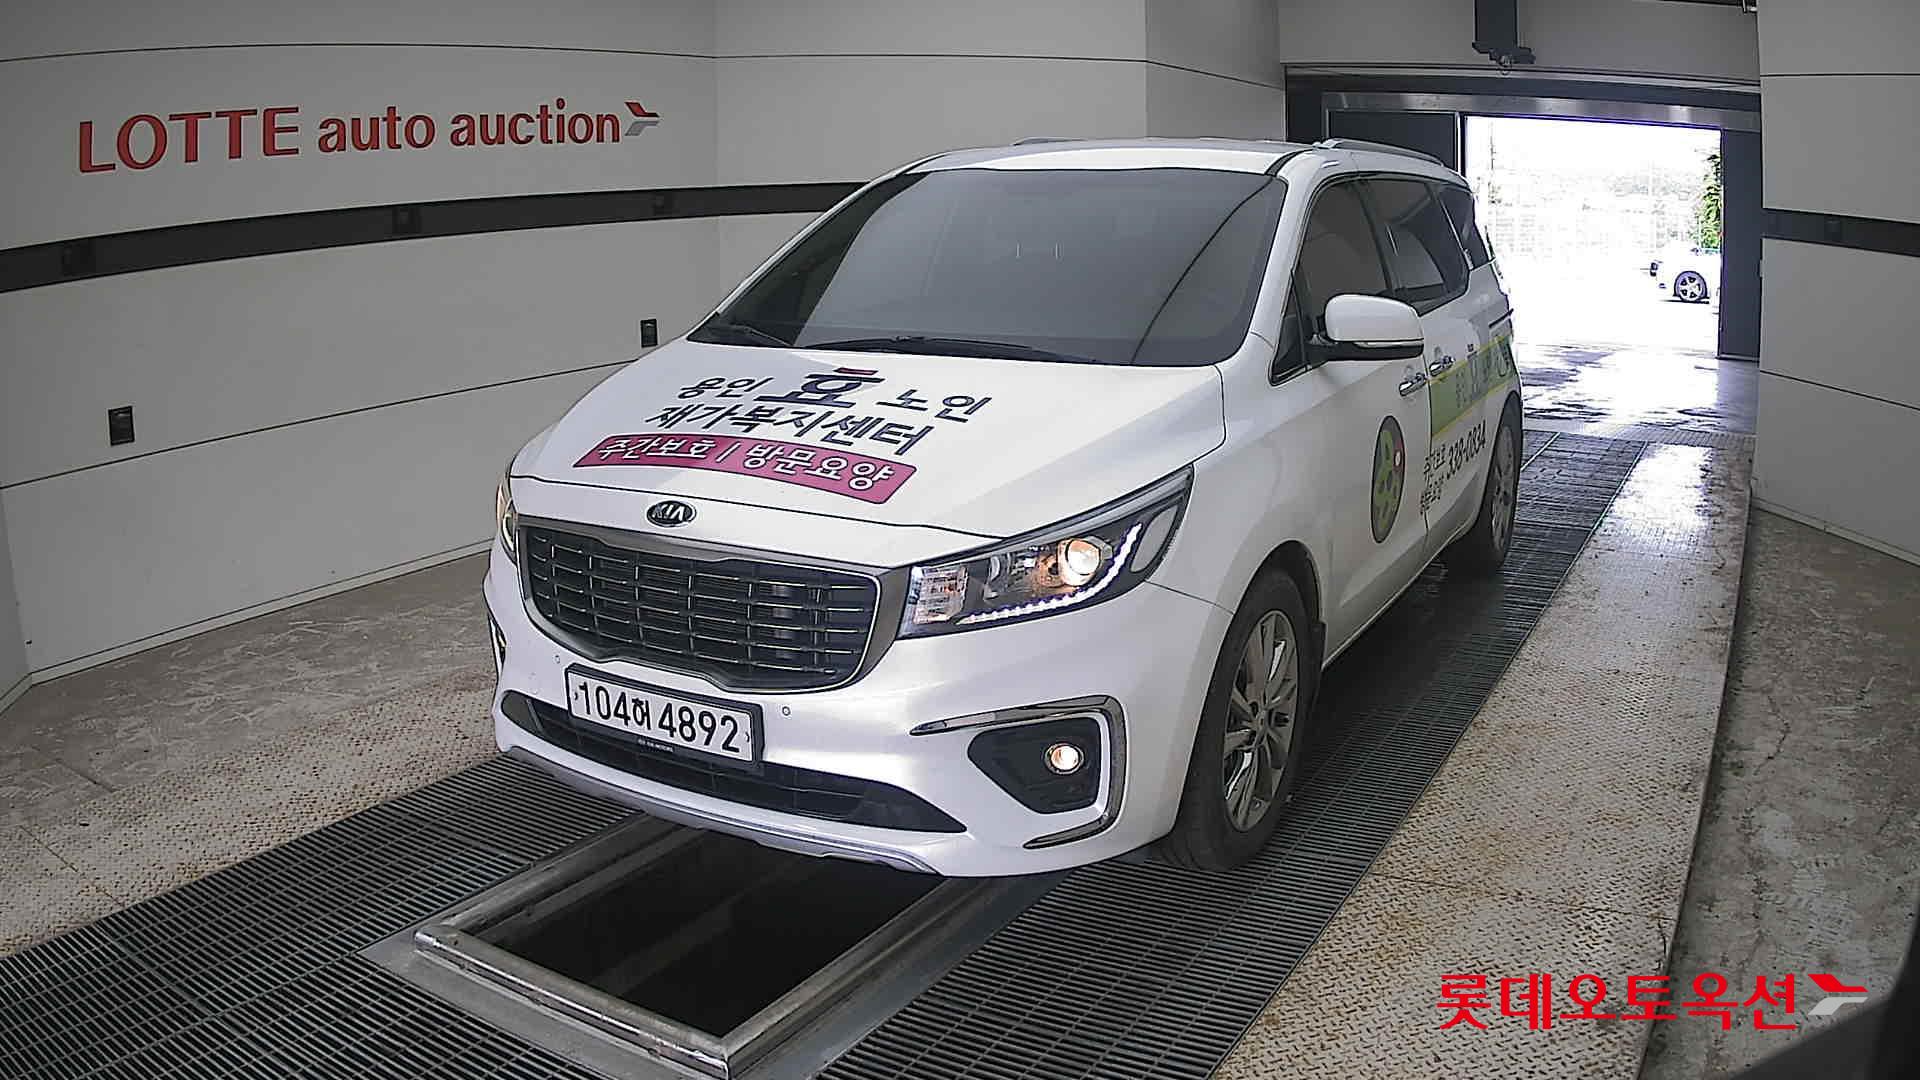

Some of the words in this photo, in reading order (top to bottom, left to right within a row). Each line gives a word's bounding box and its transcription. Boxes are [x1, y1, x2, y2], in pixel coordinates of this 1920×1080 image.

[78, 107, 301, 173] LOTTE
[316, 105, 436, 153] auto
[449, 97, 621, 147] auction
[678, 376, 774, 399] 용인
[753, 366, 884, 407] 효
[877, 388, 993, 424] 노인
[645, 403, 935, 456] 재가복지센터
[597, 437, 719, 462] 주간보호
[744, 445, 896, 491] 방문요양
